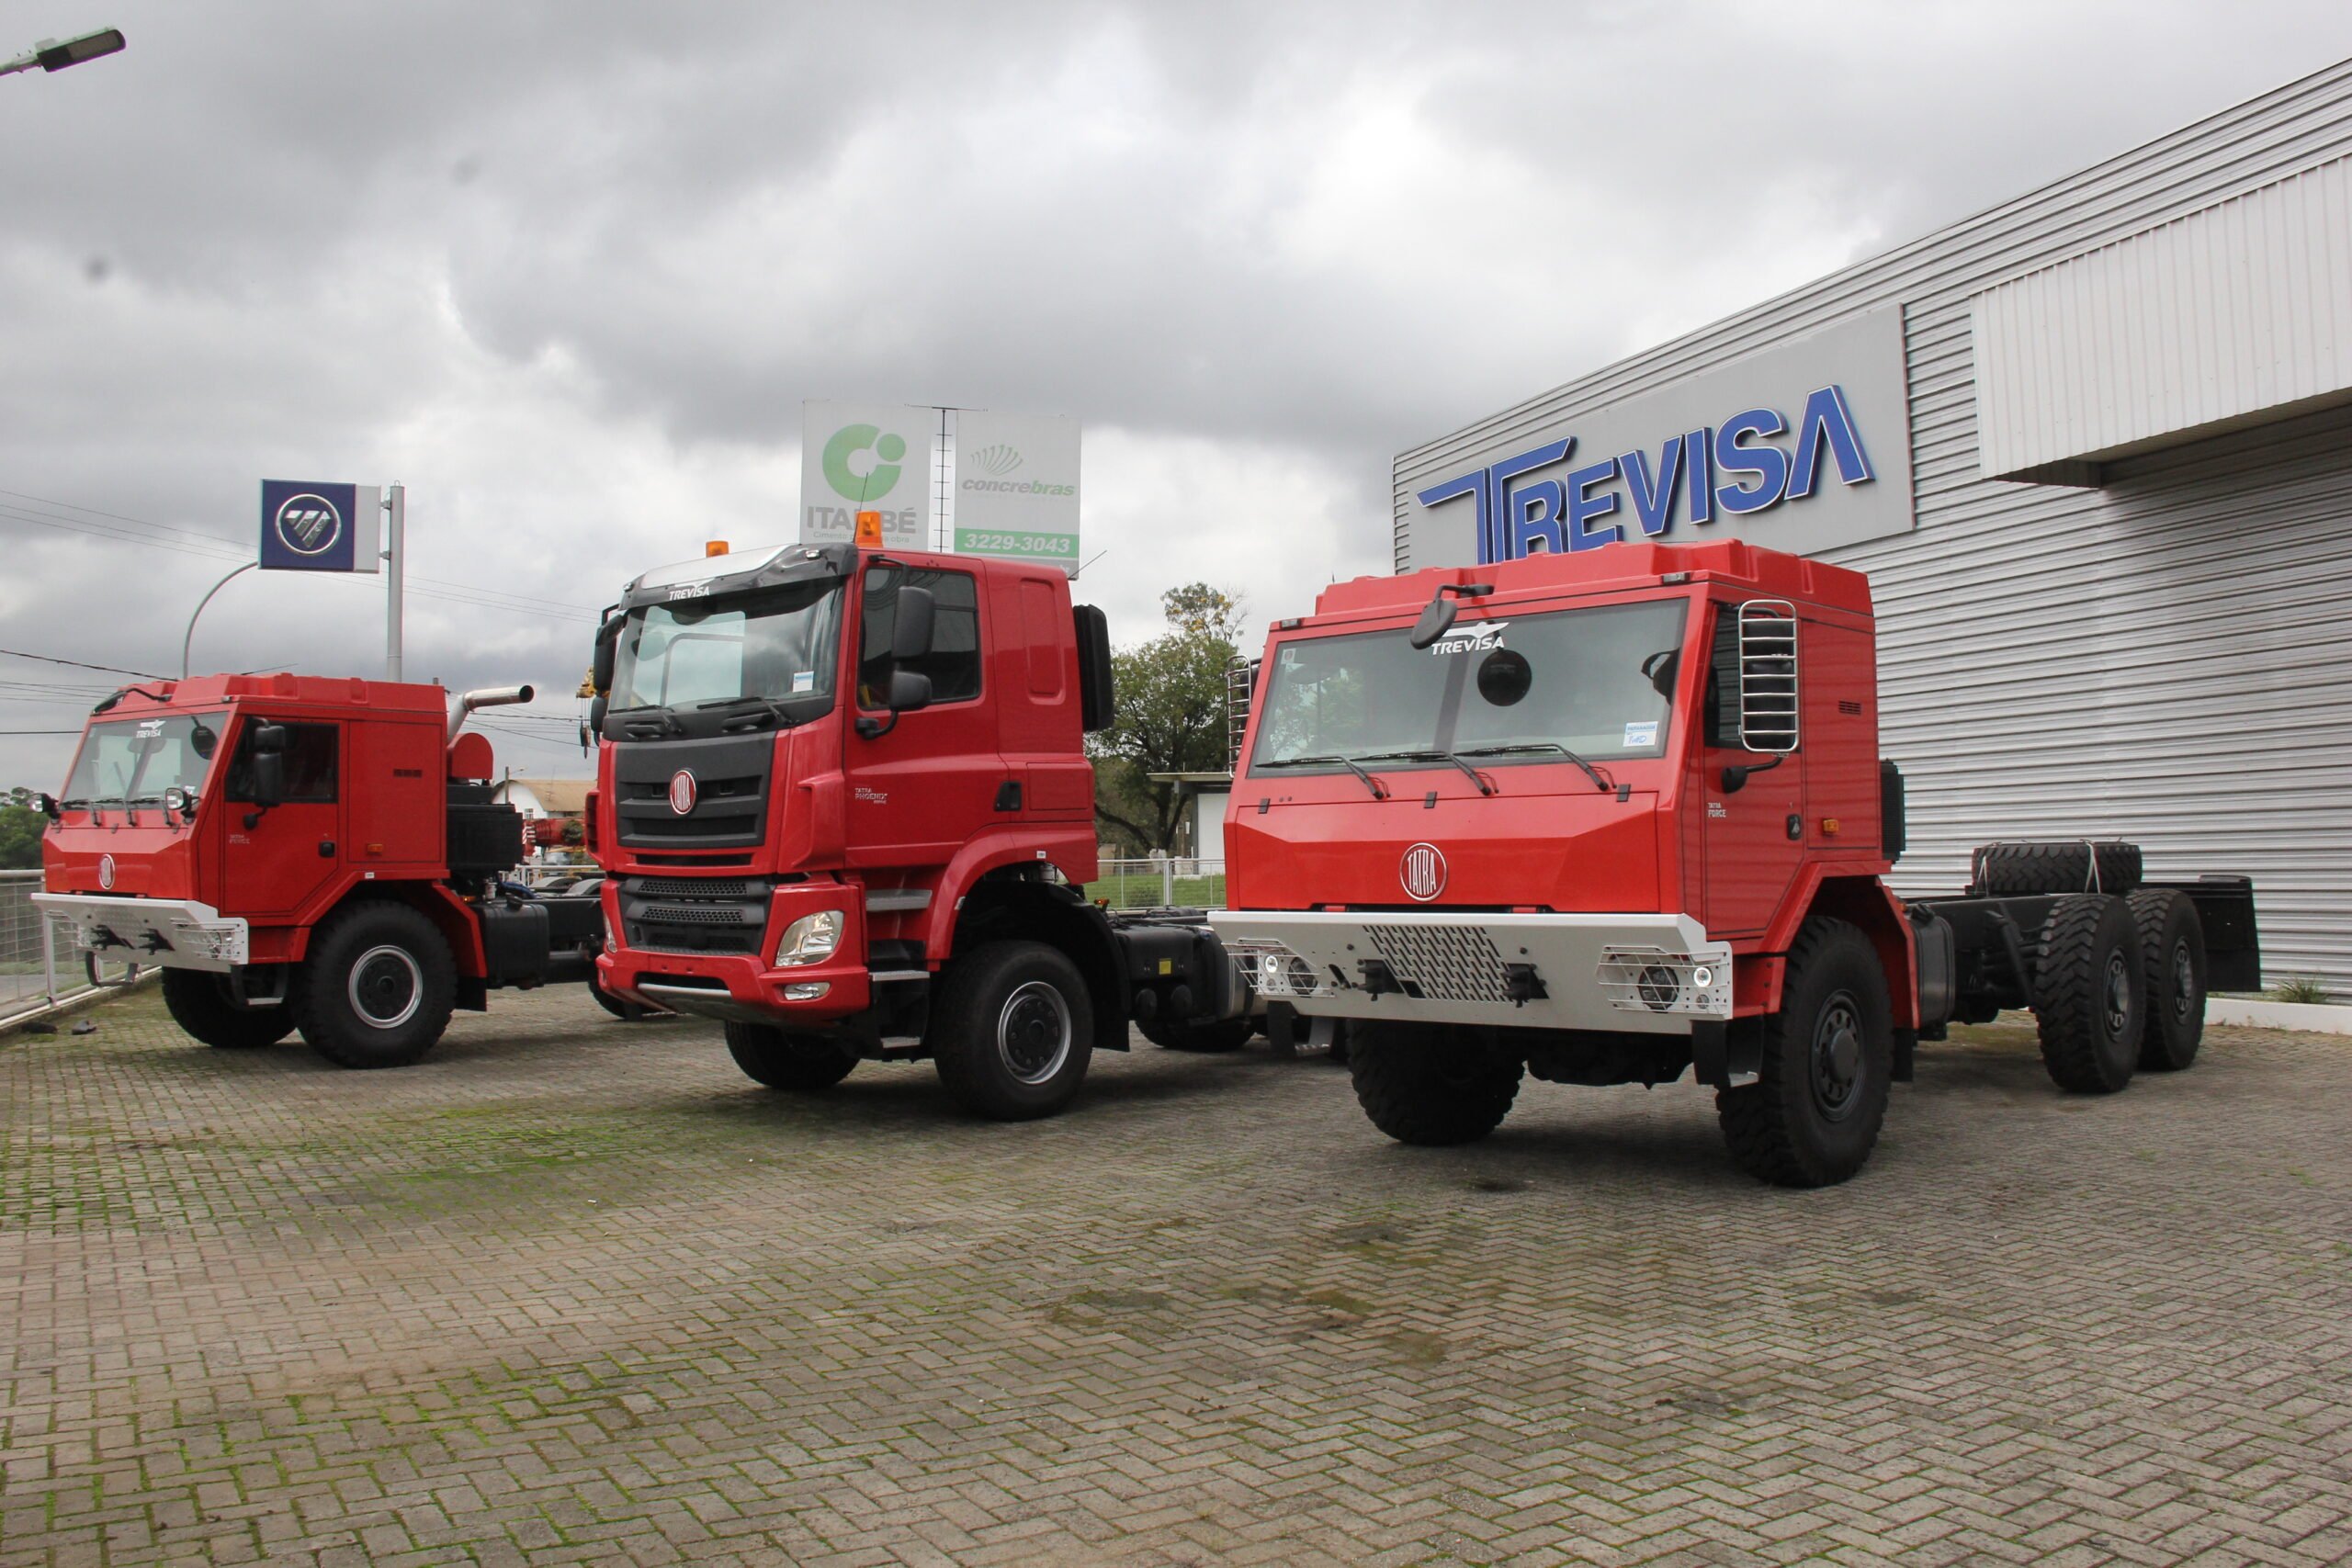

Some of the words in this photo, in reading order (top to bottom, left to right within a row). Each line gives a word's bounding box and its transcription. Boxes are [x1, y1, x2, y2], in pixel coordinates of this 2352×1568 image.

[1417, 384, 1874, 566] TREVISA
[962, 479, 1075, 496] concrebras
[807, 506, 917, 534] ITABÉ
[964, 534, 1071, 553] 3229-3043
[669, 586, 710, 602] TREVISA
[1430, 636, 1505, 656] TREVISA
[673, 774, 691, 811] TATRA
[1407, 849, 1437, 896] TATRA
